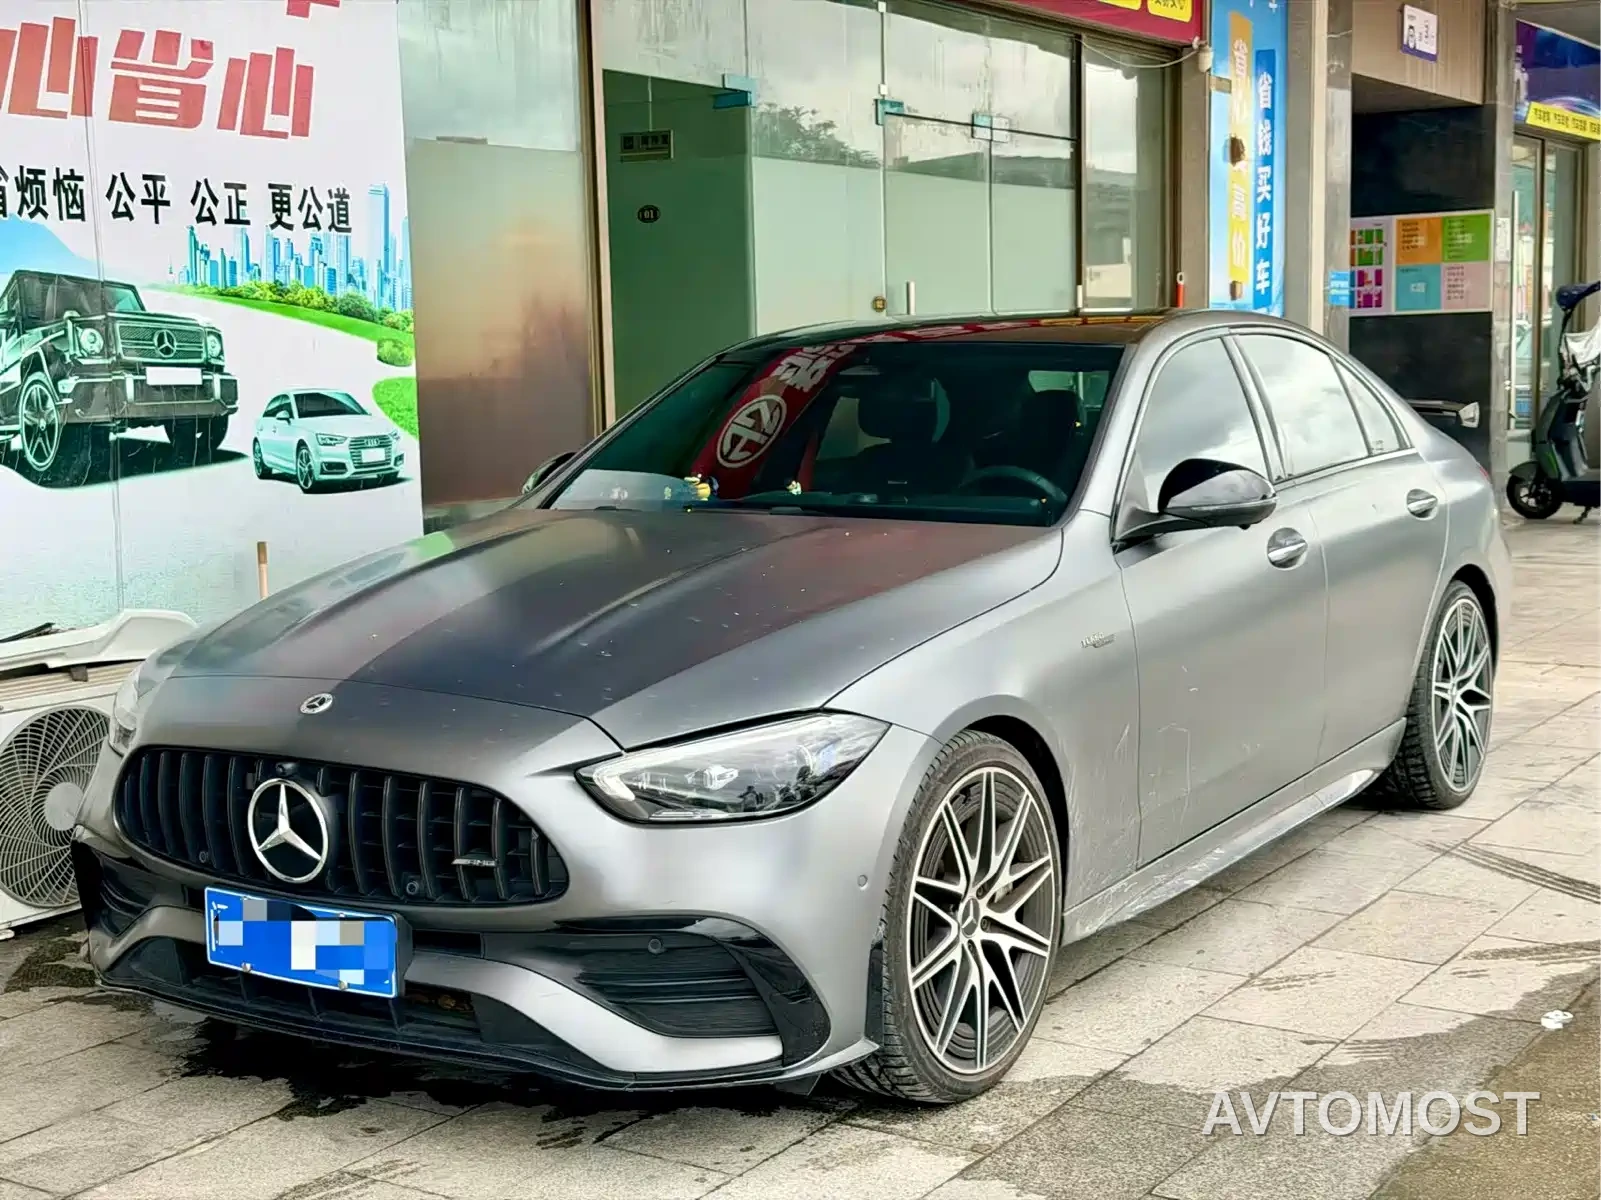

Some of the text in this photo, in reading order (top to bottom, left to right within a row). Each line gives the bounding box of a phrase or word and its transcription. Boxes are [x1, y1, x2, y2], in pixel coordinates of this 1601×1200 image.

[0, 165, 353, 234] 烦恼 公平 公正 更公道
[1255, 71, 1273, 295] 省钱买好车
